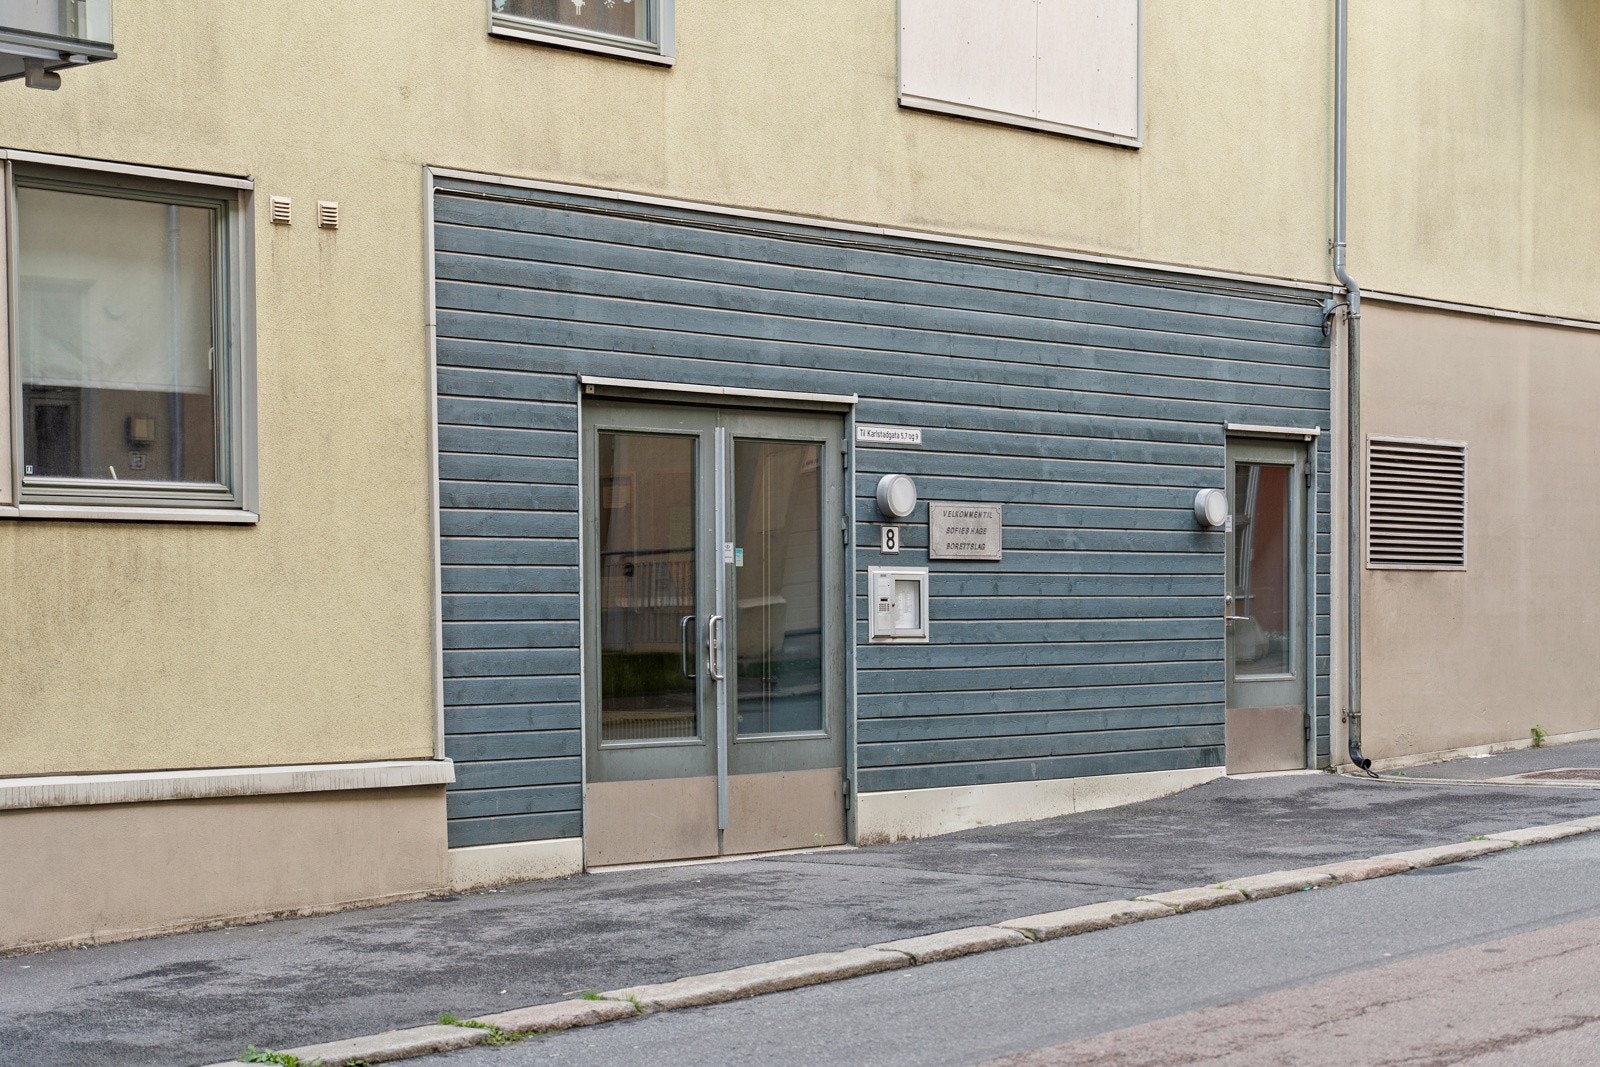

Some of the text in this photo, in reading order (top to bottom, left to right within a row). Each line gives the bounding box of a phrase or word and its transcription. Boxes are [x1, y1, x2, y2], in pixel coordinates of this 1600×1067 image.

[867, 430, 900, 440] Karlstadgata
[946, 526, 970, 534] SOFIES
[886, 528, 895, 550] 8
[946, 542, 986, 550] BORETTSLAG
